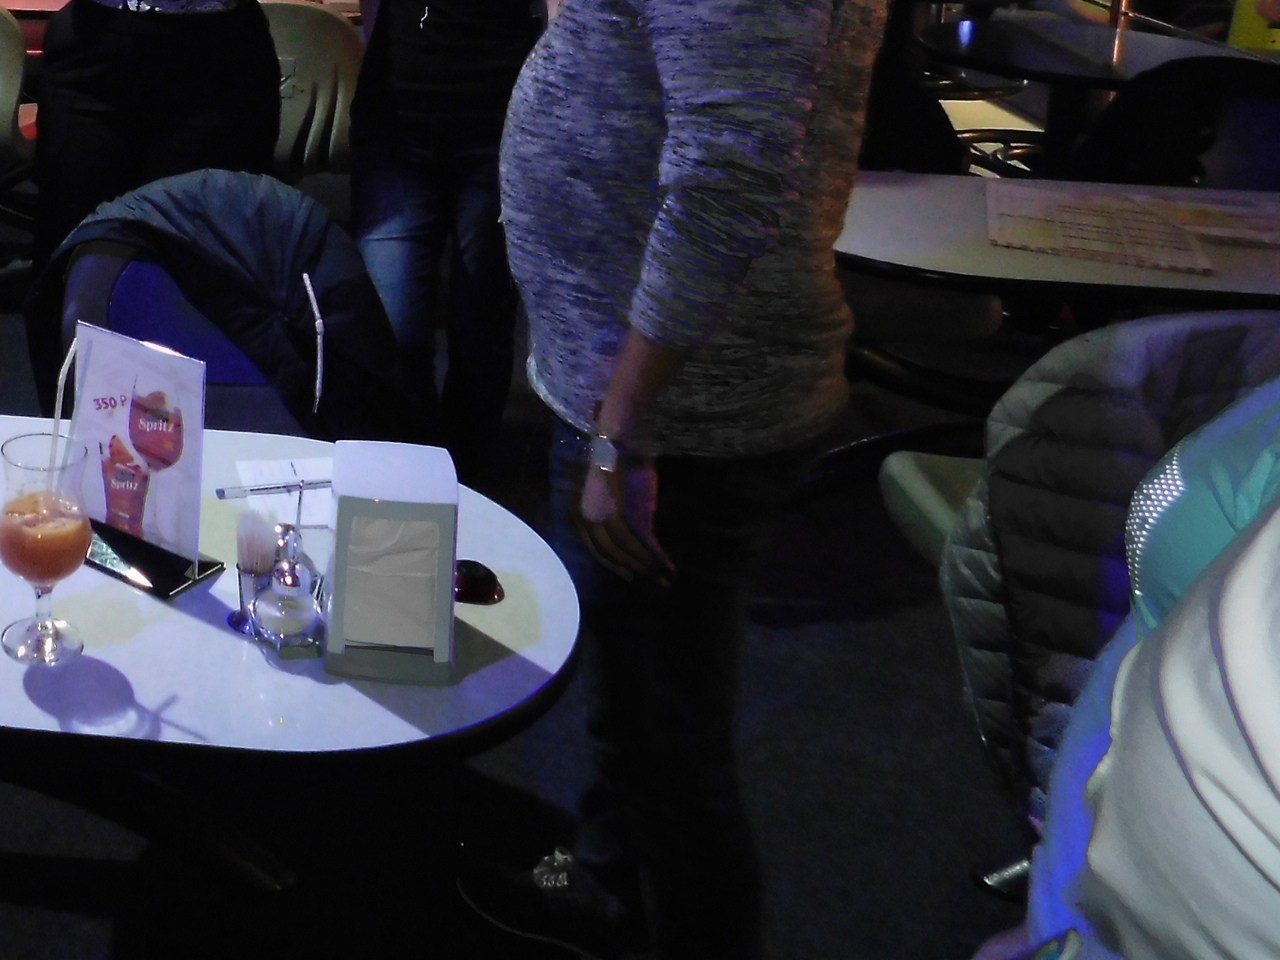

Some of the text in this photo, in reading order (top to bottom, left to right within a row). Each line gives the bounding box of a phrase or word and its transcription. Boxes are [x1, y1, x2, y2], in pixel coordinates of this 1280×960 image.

[93, 396, 118, 411] 350
[138, 418, 175, 433] Spritz
[110, 478, 139, 491] Spritz
